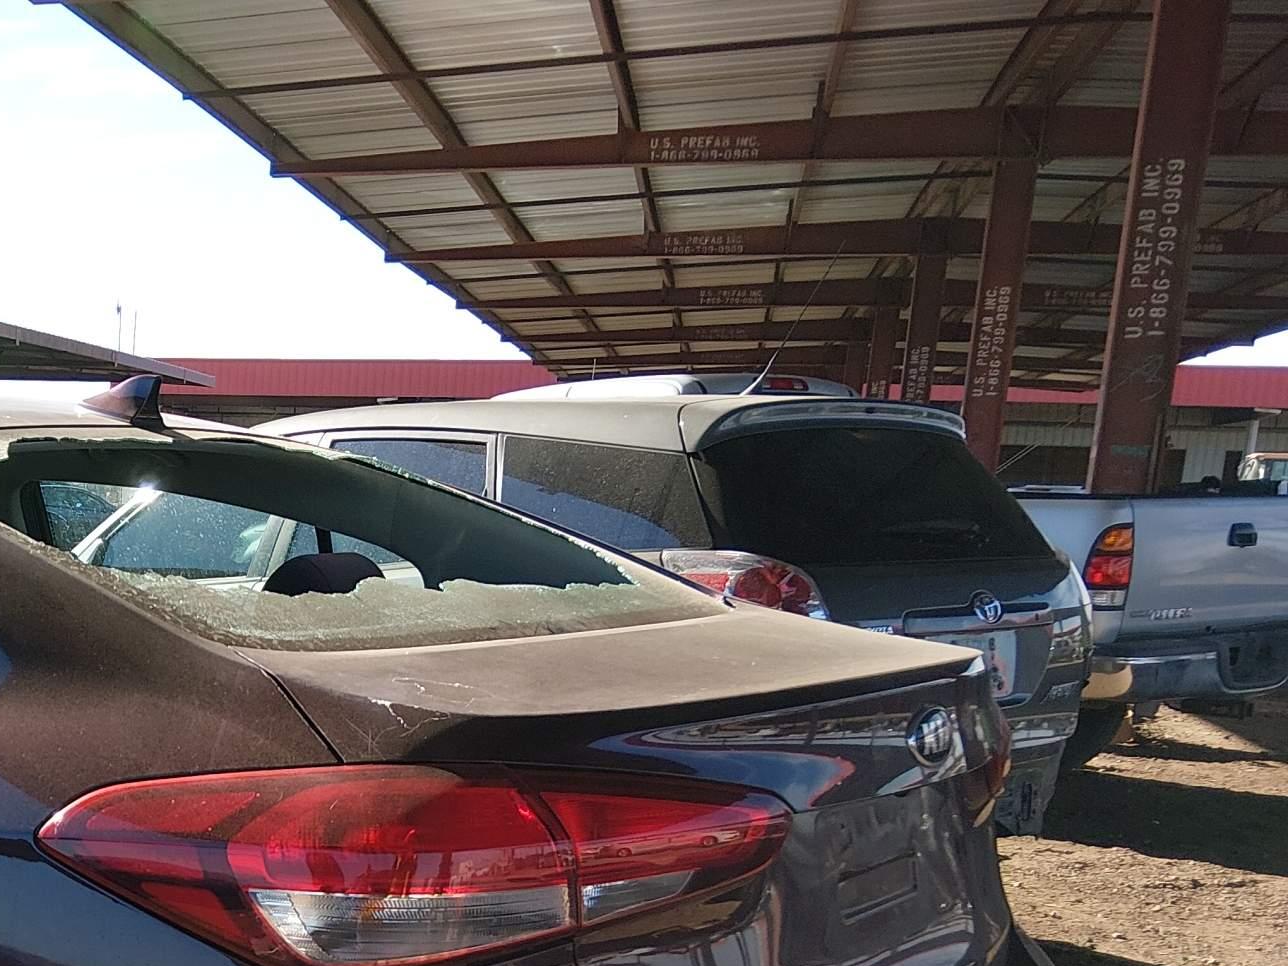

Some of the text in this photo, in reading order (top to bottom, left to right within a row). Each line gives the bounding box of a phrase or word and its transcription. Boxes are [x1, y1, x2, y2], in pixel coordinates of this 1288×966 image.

[1141, 158, 1164, 198] INC.
[1130, 208, 1157, 288] PREFAB
[1147, 158, 1186, 336] 1-866-799-0969
[976, 316, 995, 367] PREFAB
